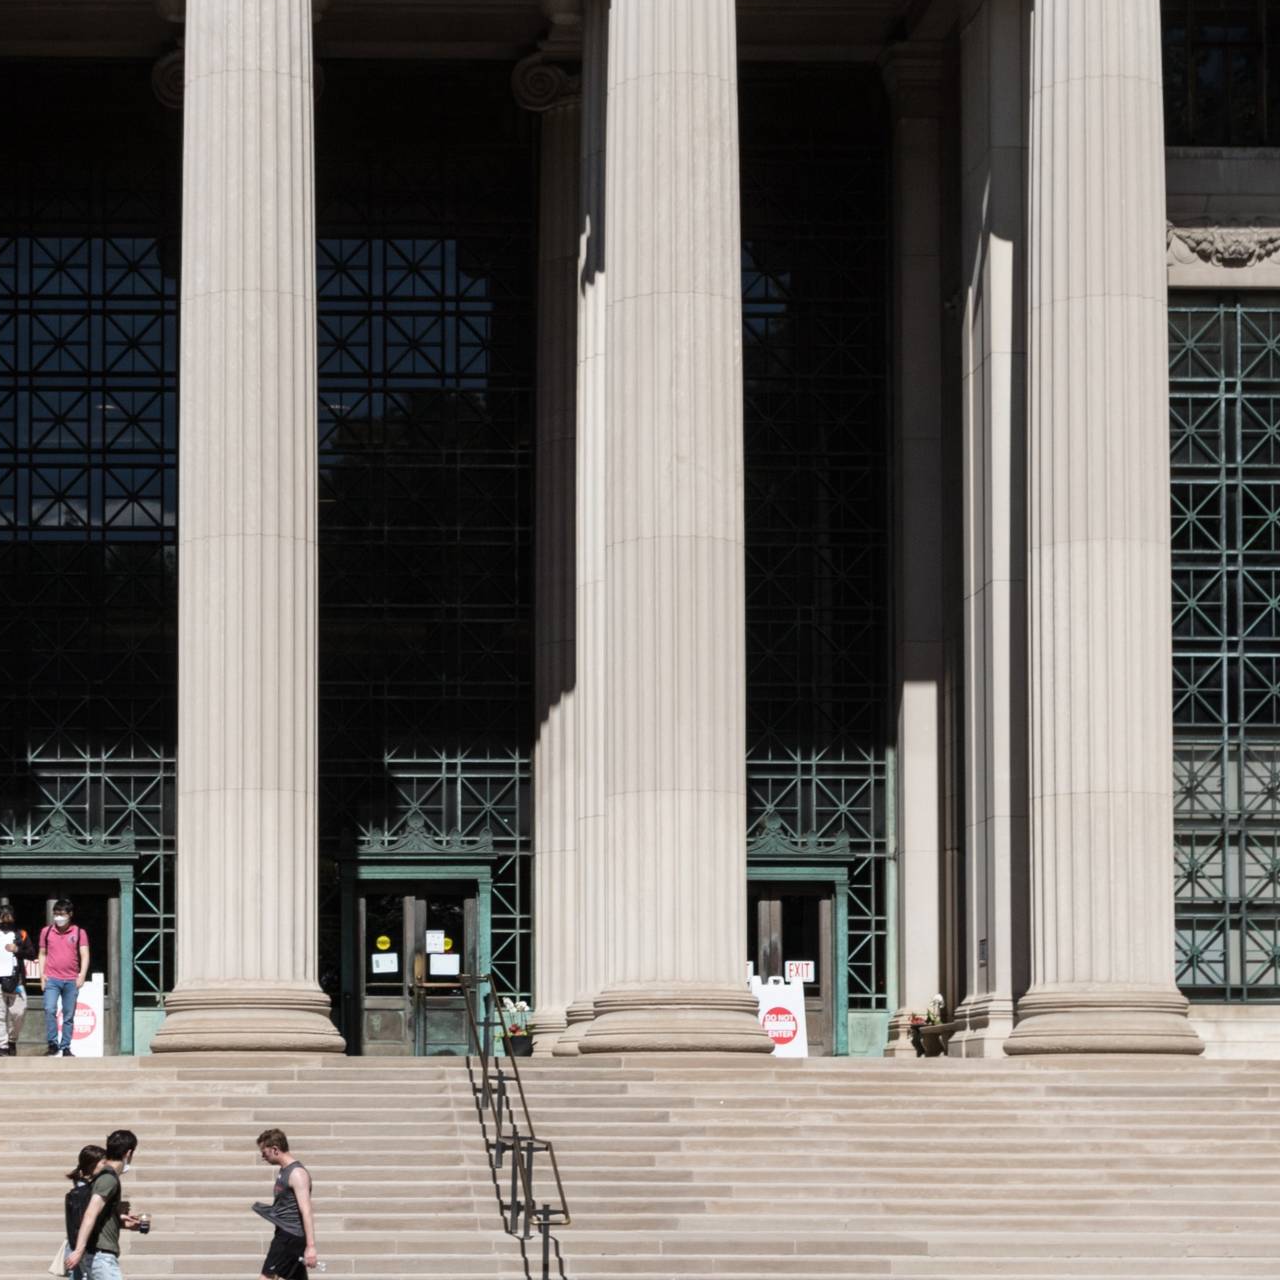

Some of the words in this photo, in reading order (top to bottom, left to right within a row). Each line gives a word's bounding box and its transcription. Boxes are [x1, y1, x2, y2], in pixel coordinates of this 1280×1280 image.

[789, 963, 810, 978] EXIT
[766, 1014, 777, 1022] DO
[778, 1014, 794, 1022] NOT
[768, 1030, 793, 1038] ENTER
